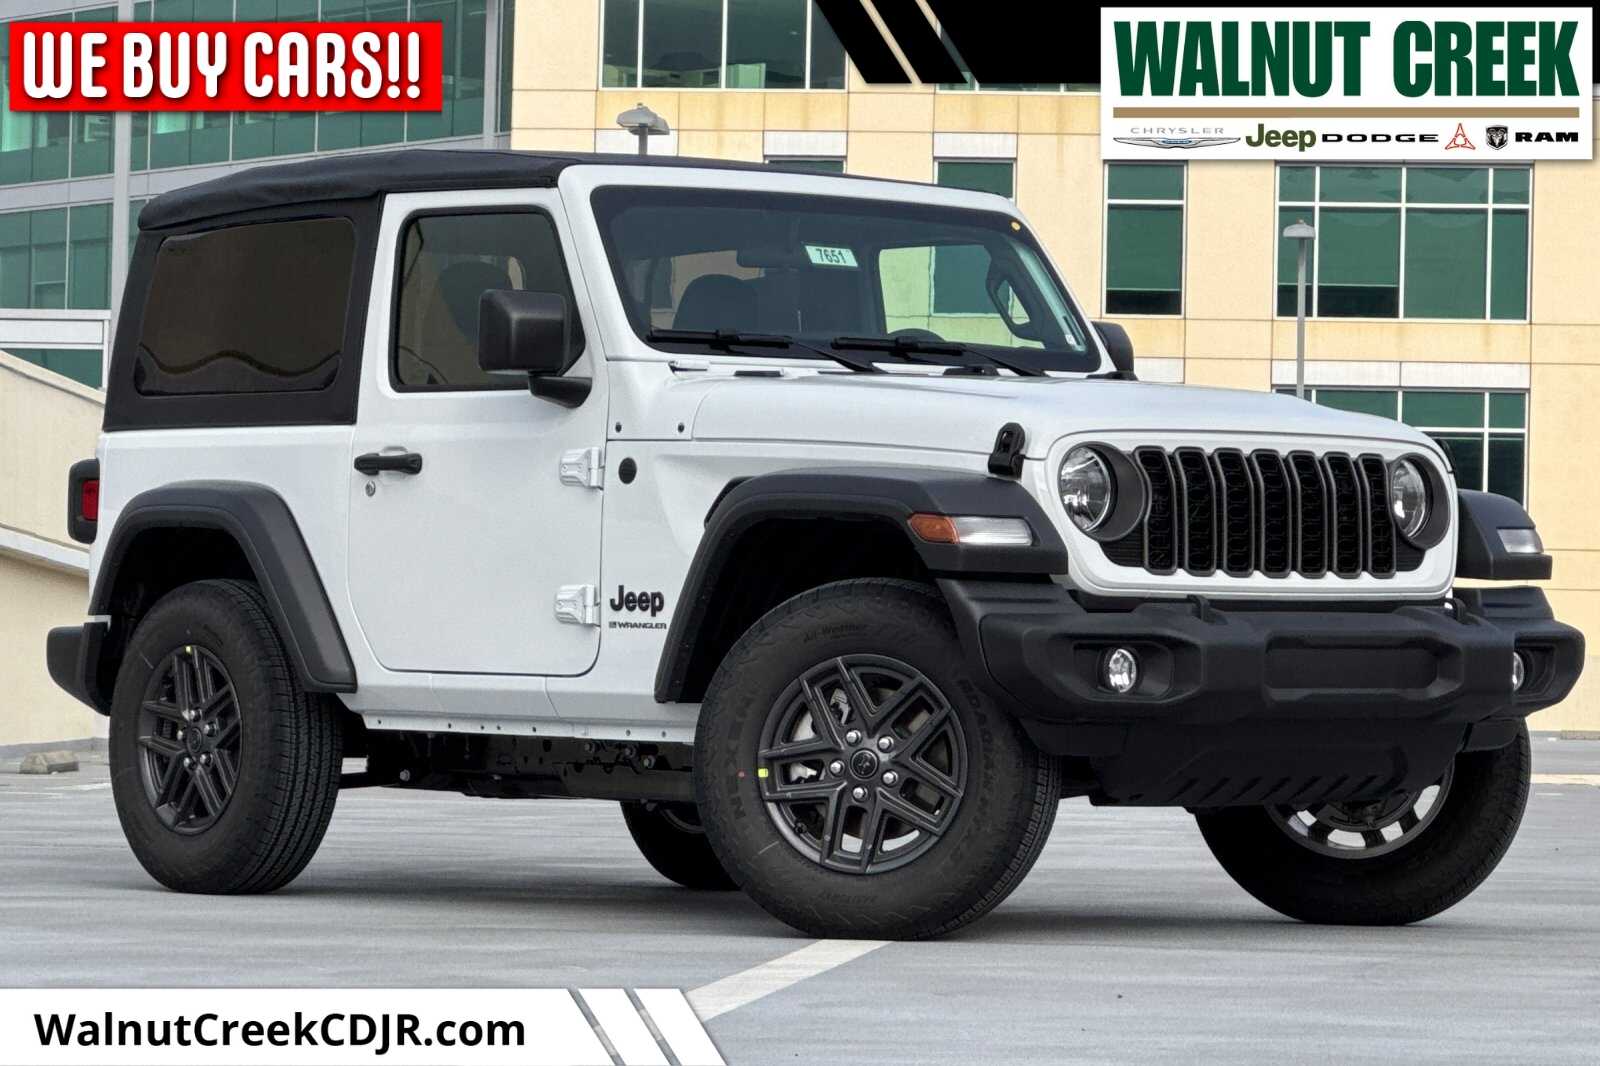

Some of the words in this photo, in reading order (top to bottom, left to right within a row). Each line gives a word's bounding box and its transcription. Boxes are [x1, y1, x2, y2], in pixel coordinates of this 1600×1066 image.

[815, 247, 847, 264] 7651
[609, 584, 665, 617] Jeep
[618, 621, 667, 630] WRANGLER
